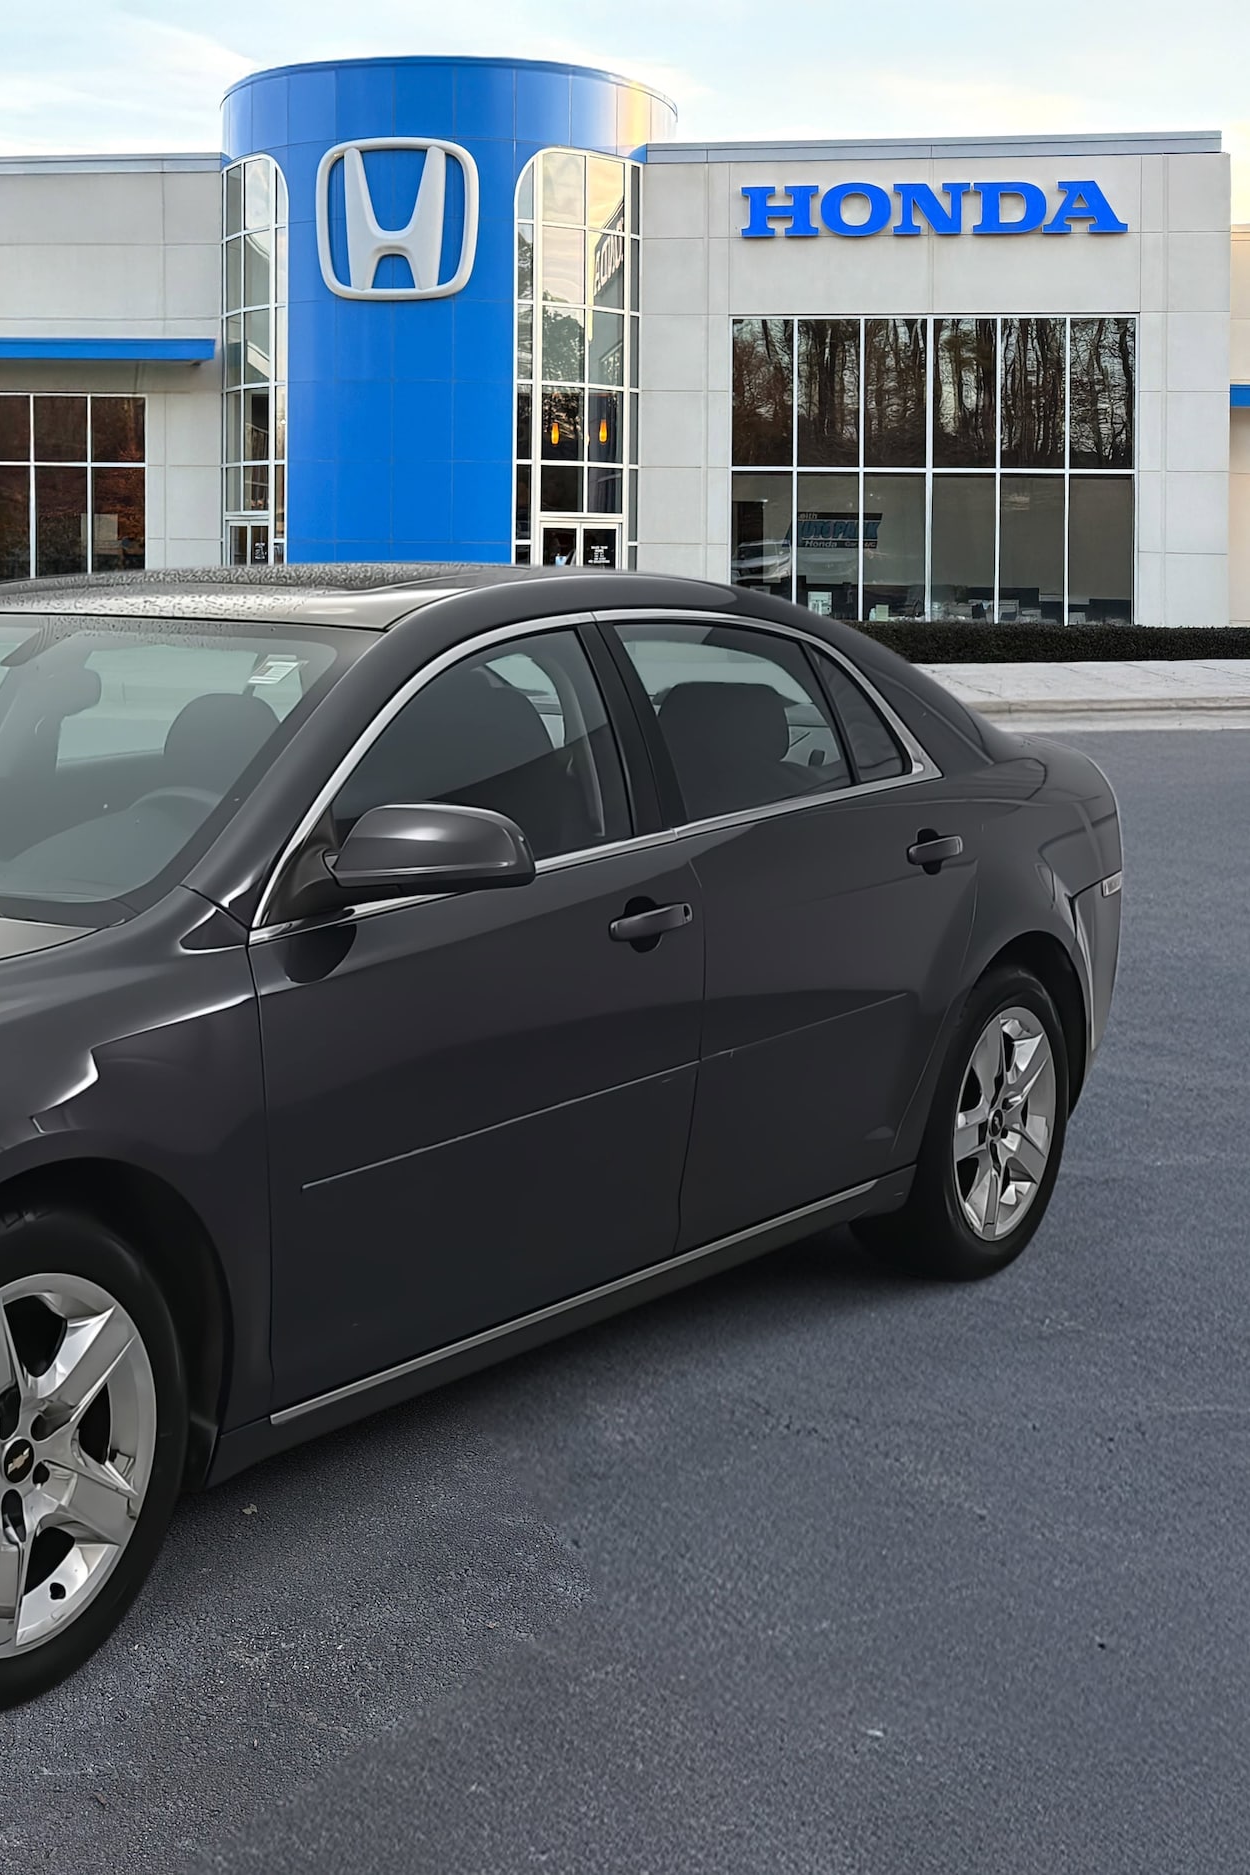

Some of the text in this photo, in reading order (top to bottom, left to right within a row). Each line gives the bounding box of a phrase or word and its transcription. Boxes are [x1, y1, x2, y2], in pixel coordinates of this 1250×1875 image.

[741, 180, 1128, 237] HONDA
[798, 512, 818, 520] eith
[804, 540, 837, 548] Honda
